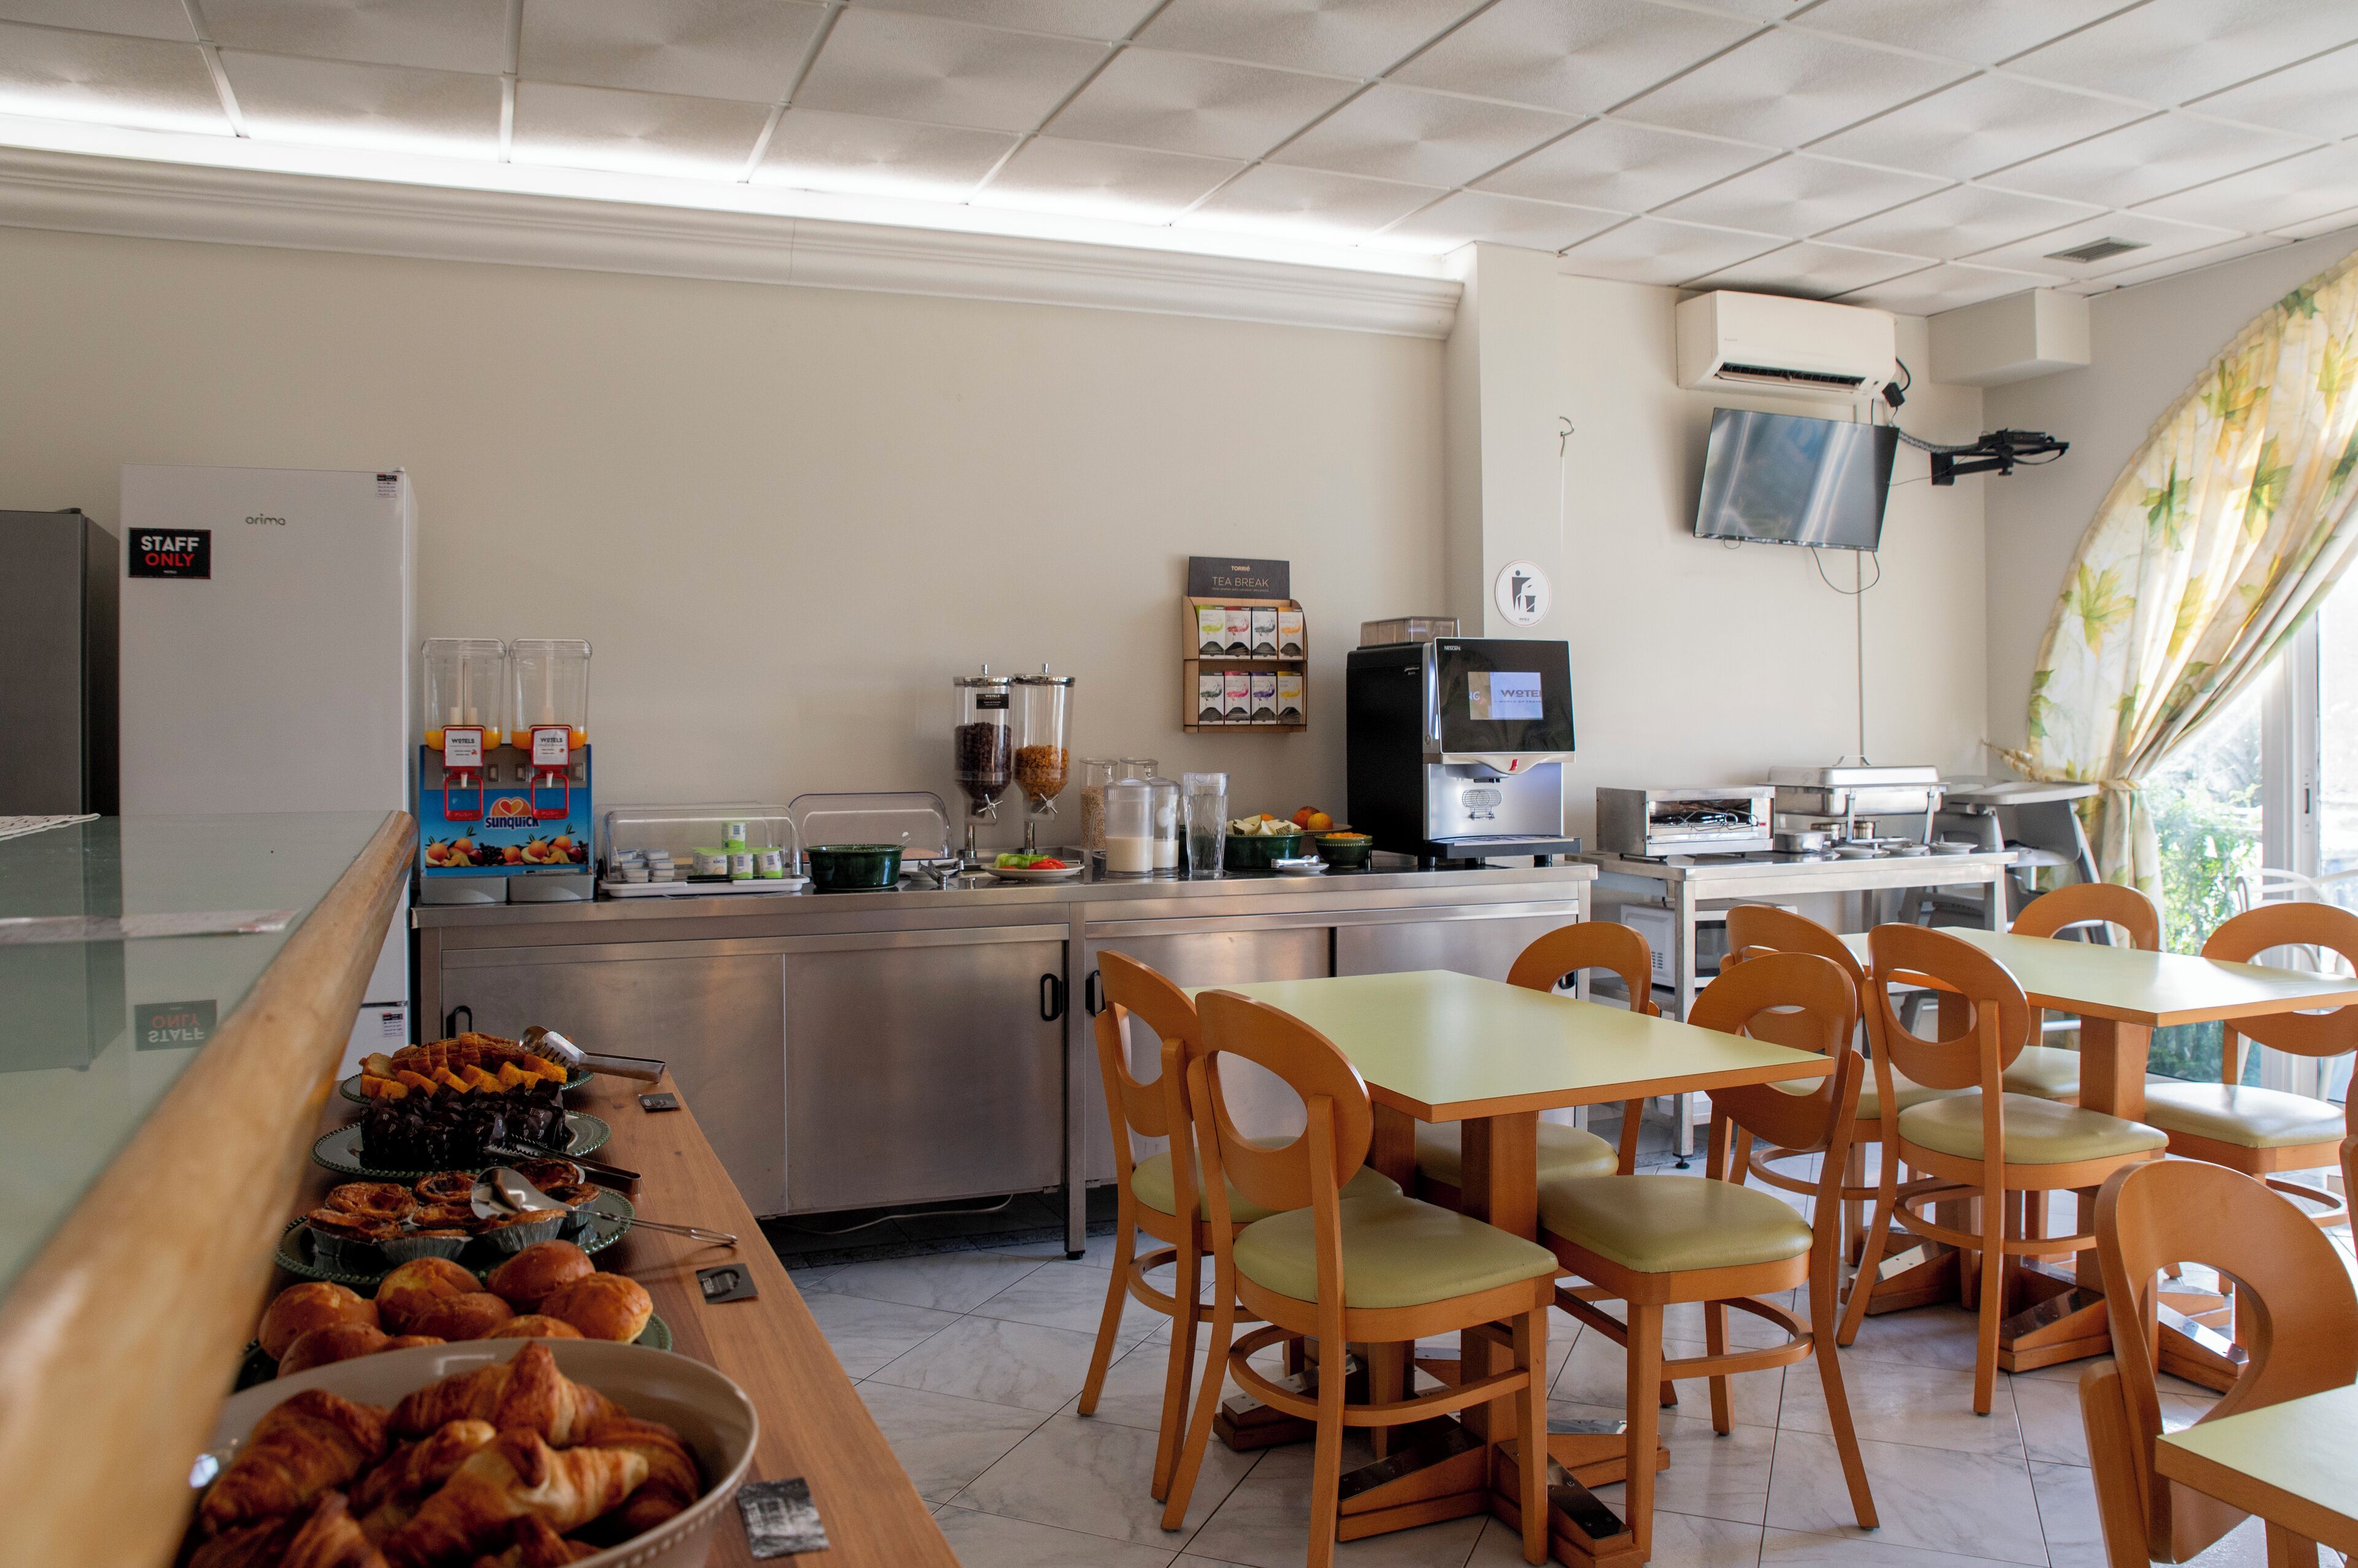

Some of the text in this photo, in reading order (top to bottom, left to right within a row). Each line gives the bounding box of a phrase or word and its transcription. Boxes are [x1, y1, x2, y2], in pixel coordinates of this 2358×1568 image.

[246, 513, 286, 526] orima
[141, 535, 200, 552] STAFF
[145, 552, 195, 567] ONLY
[1212, 576, 1269, 588] TEA BREAK
[485, 816, 539, 829] sunquick
